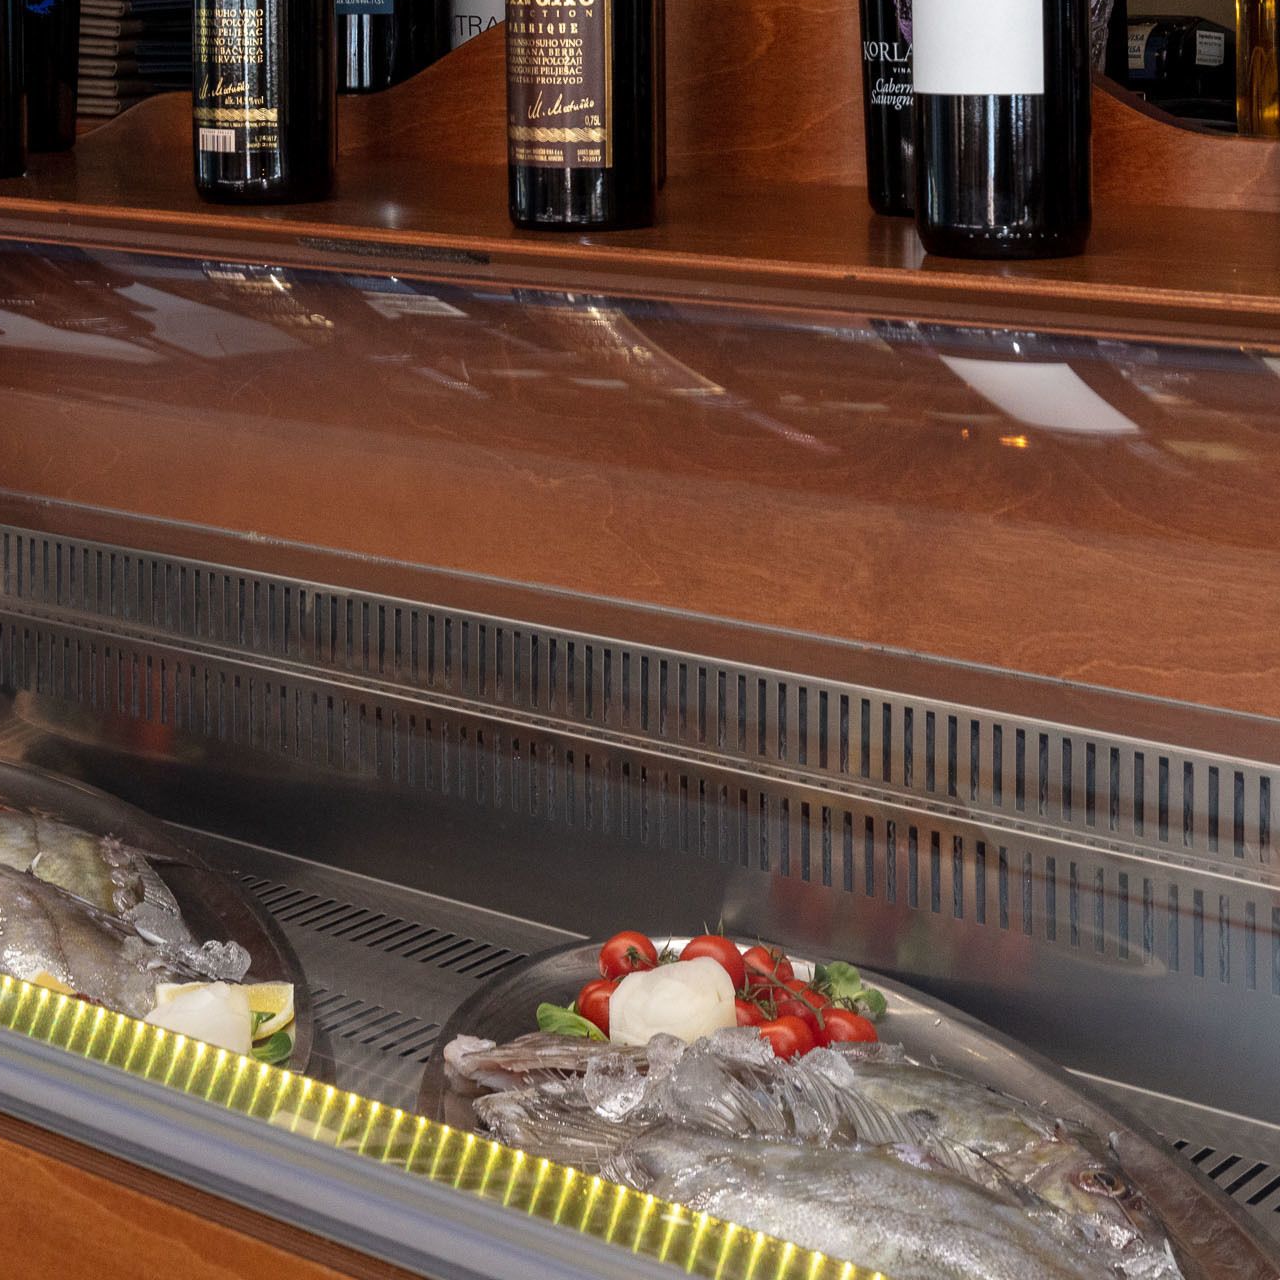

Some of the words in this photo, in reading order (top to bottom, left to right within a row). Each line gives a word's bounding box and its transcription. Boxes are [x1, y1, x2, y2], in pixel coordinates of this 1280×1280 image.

[240, 8, 264, 18] VINO
[536, 39, 558, 48] SUHO
[560, 38, 583, 48] VINO
[548, 48, 583, 57] BERBA
[542, 56, 583, 66] POLOŽAJI
[540, 66, 583, 76] PELJEŠAC
[536, 76, 583, 85] PROIZVOD
